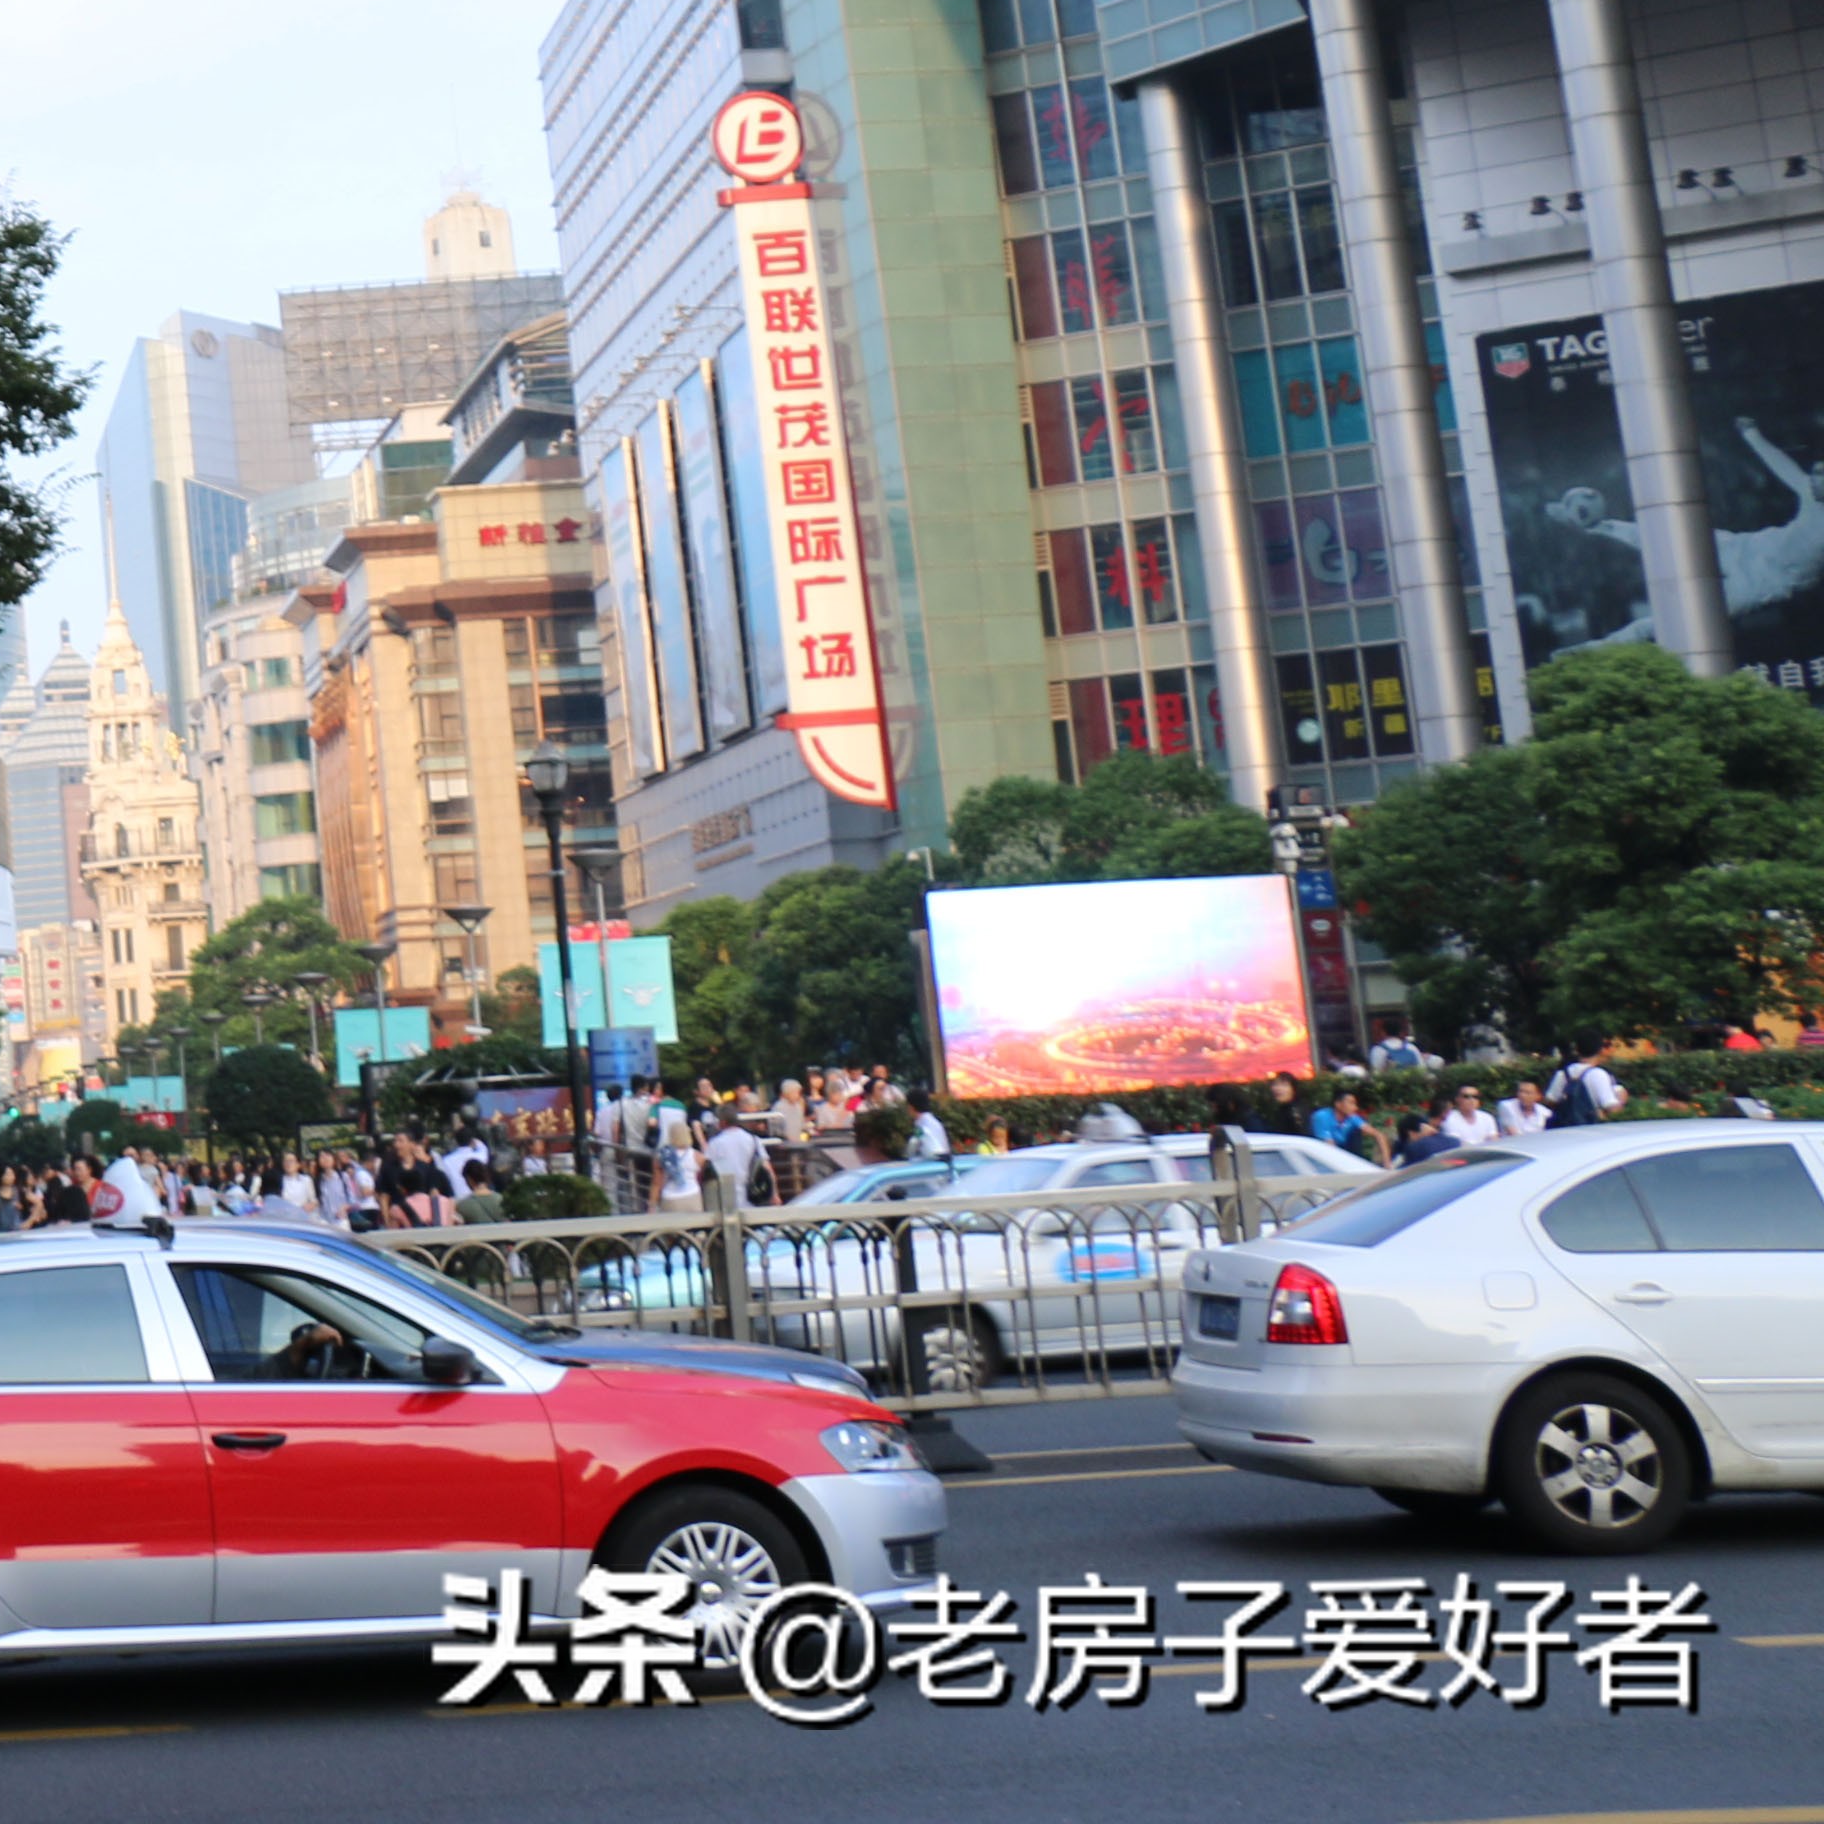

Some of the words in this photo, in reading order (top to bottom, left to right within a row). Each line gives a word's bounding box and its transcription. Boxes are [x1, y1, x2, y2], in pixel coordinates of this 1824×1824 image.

[753, 229, 858, 681] 百联世茂国际广场
[1536, 330, 1609, 360] TAG
